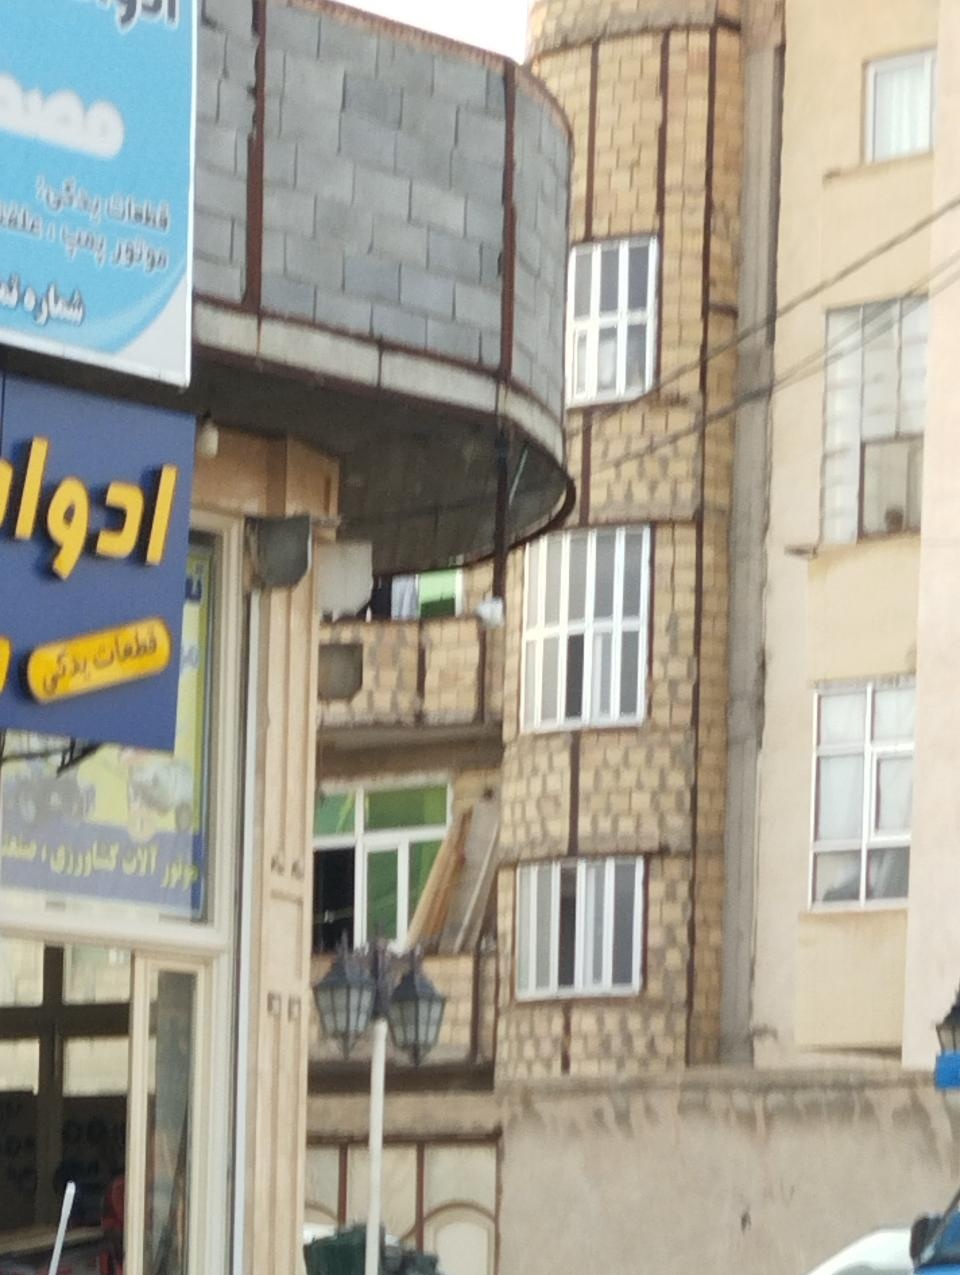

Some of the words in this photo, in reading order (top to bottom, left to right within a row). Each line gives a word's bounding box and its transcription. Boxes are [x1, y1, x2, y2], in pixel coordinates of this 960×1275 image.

[106, 193, 170, 232] قطعات
[113, 238, 168, 273] موتور
[92, 627, 158, 670] قطعات
